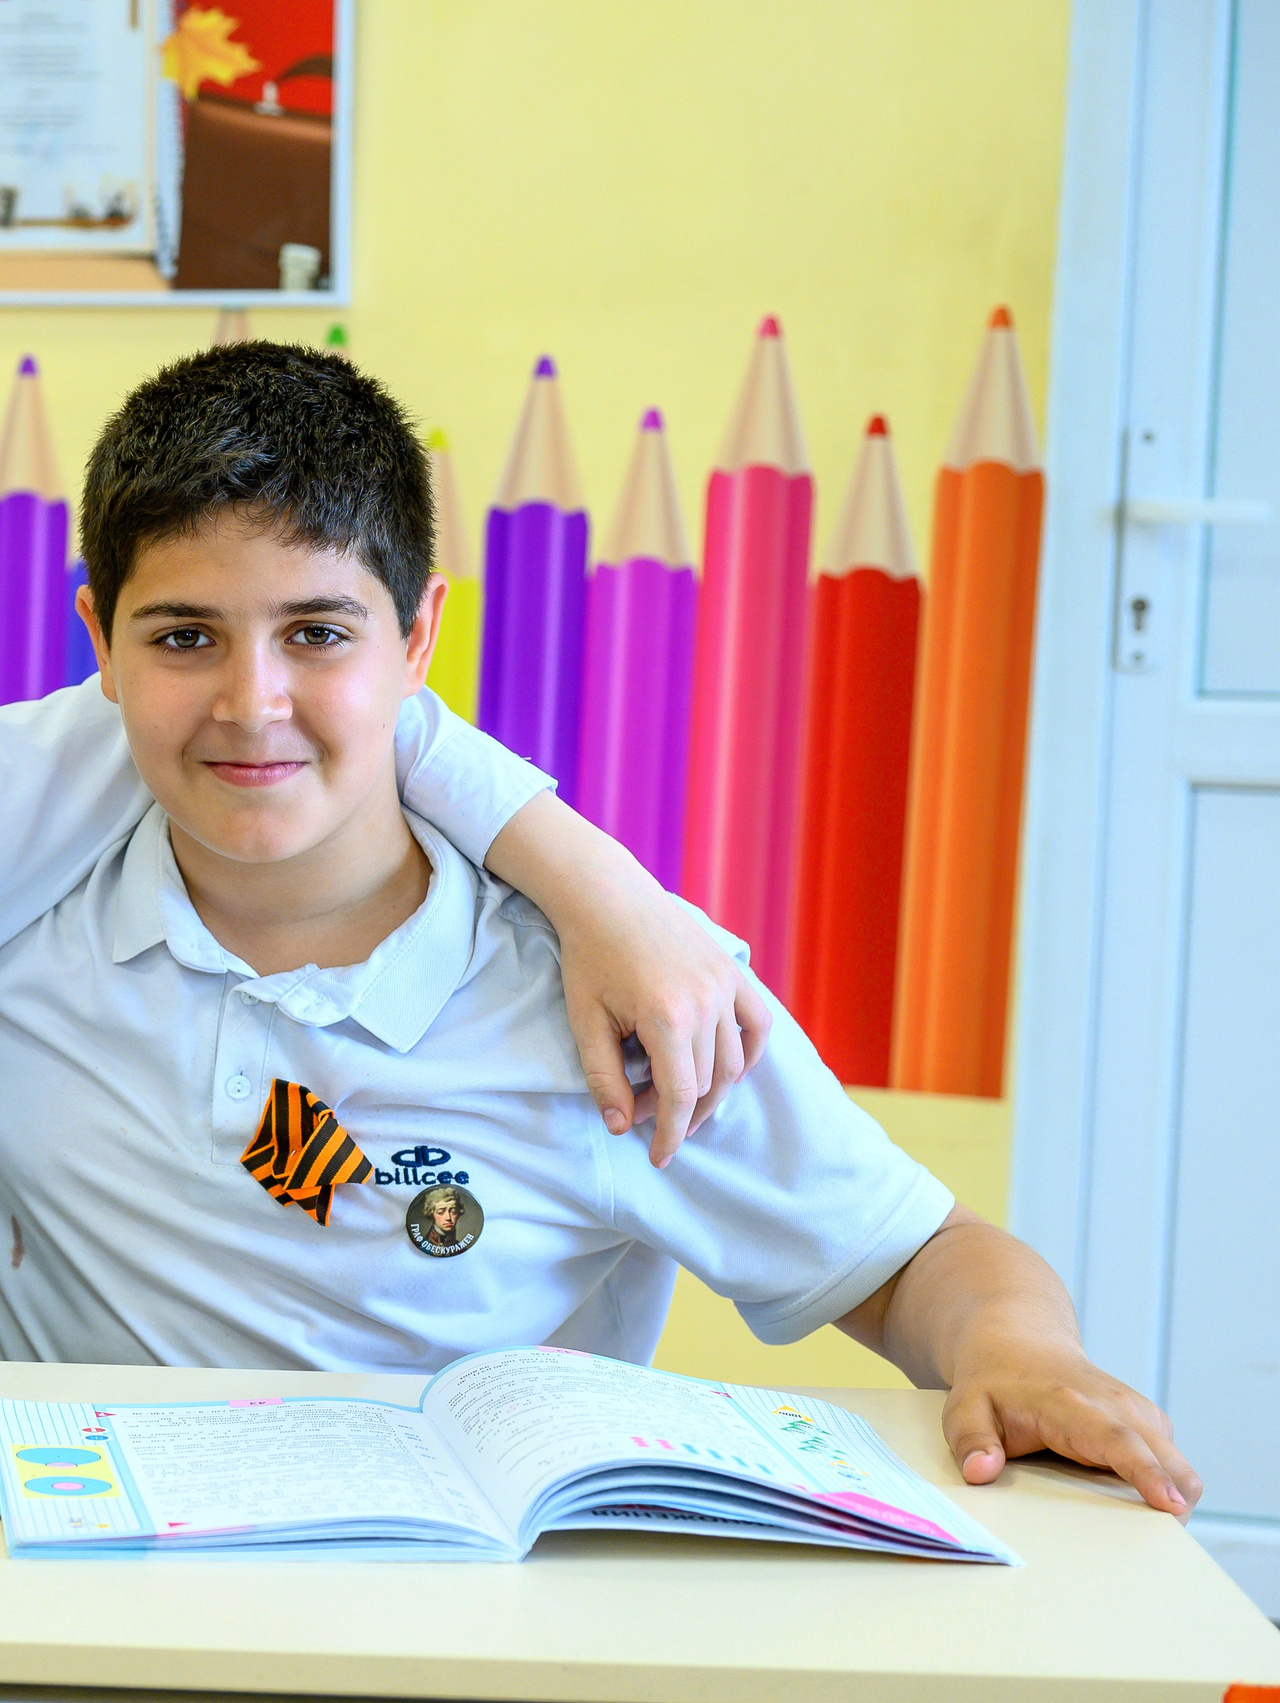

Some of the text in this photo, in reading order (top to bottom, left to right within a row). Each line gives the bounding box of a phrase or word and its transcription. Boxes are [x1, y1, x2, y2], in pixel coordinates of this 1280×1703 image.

[374, 1167, 470, 1186] billcee
[410, 1223, 475, 1255] ГРАФ ОБЕСКУРАЖЕН
[590, 1509, 774, 1527] ОЖЕНИЯ
